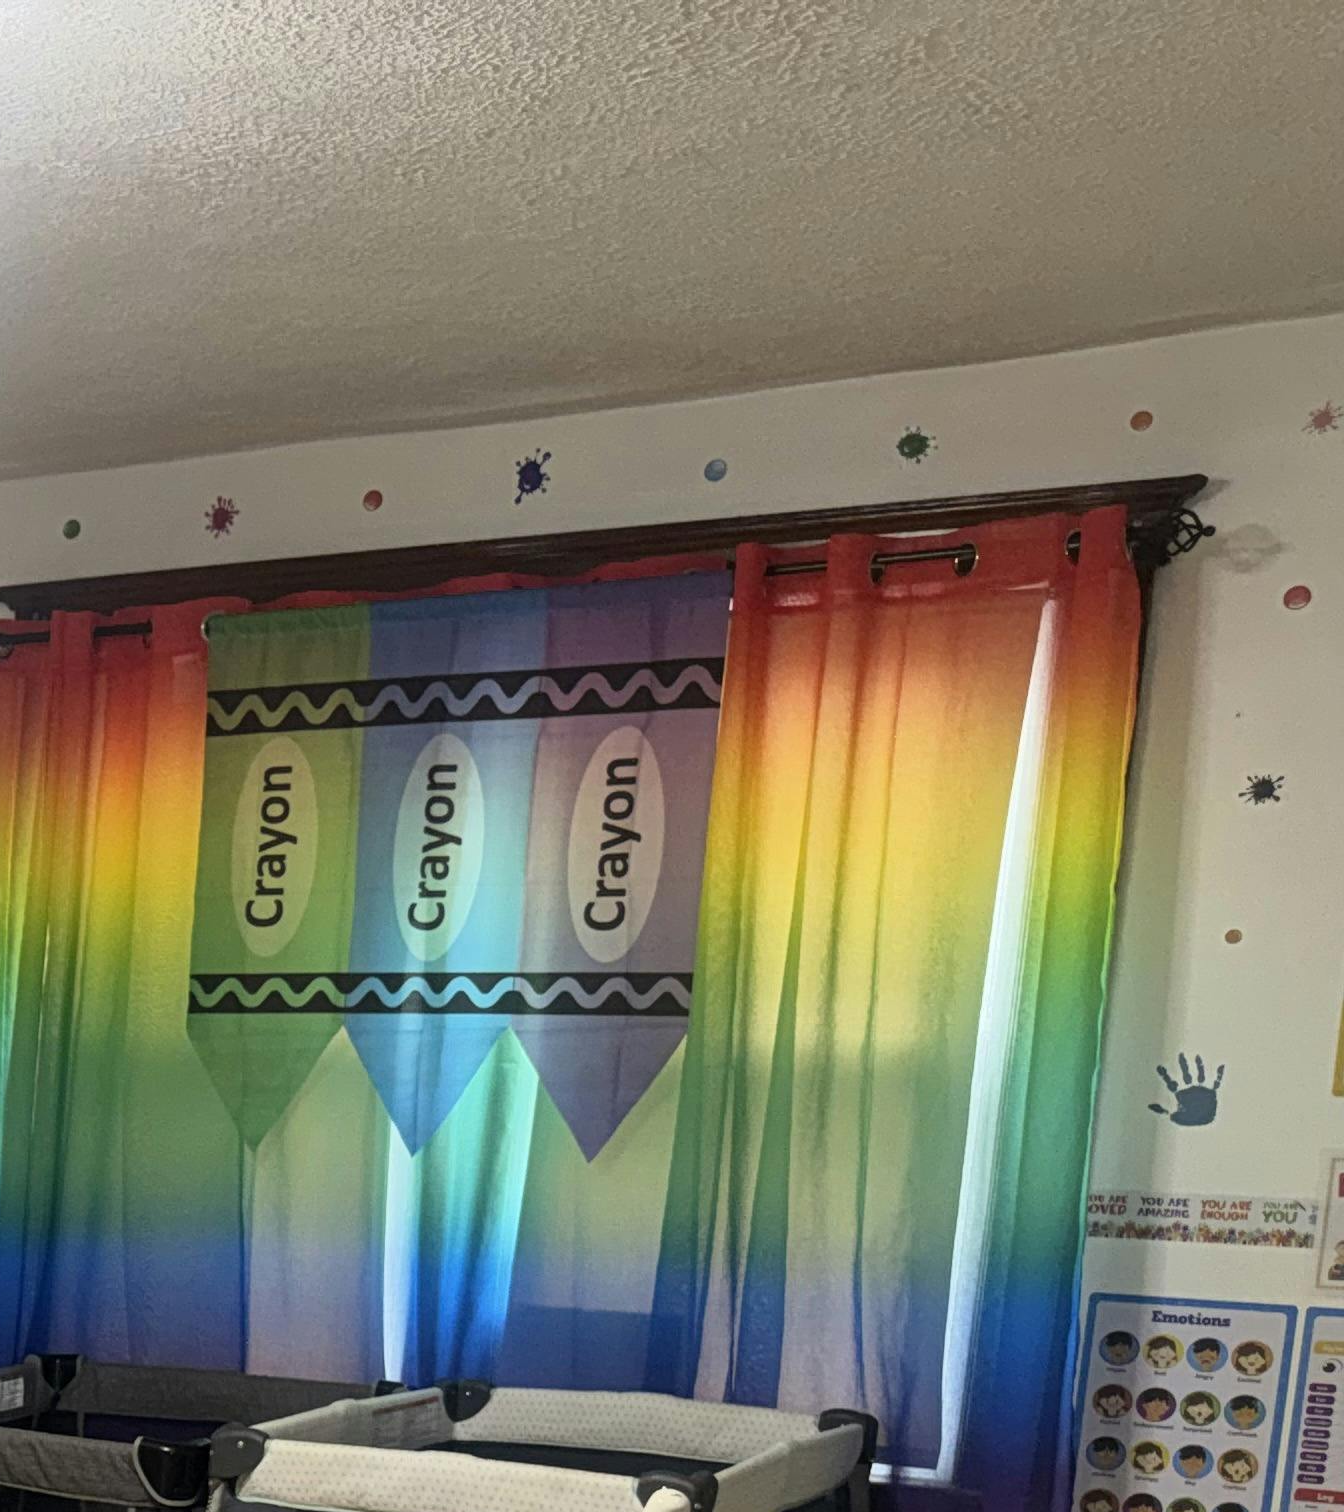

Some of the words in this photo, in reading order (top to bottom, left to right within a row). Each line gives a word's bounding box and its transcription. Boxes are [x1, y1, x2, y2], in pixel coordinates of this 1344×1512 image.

[245, 764, 298, 927] Crayon
[407, 763, 462, 931] Crayon
[583, 757, 642, 931] Crayon
[1141, 1197, 1164, 1206] YOU
[1202, 1200, 1226, 1210] YOU
[1230, 1201, 1252, 1211] ARE
[1088, 1204, 1127, 1216] OVED
[1137, 1207, 1190, 1218] AMAZING
[1201, 1211, 1248, 1221] ENOUGH
[1263, 1210, 1298, 1224] YOU
[1151, 1310, 1231, 1327] Emotions
